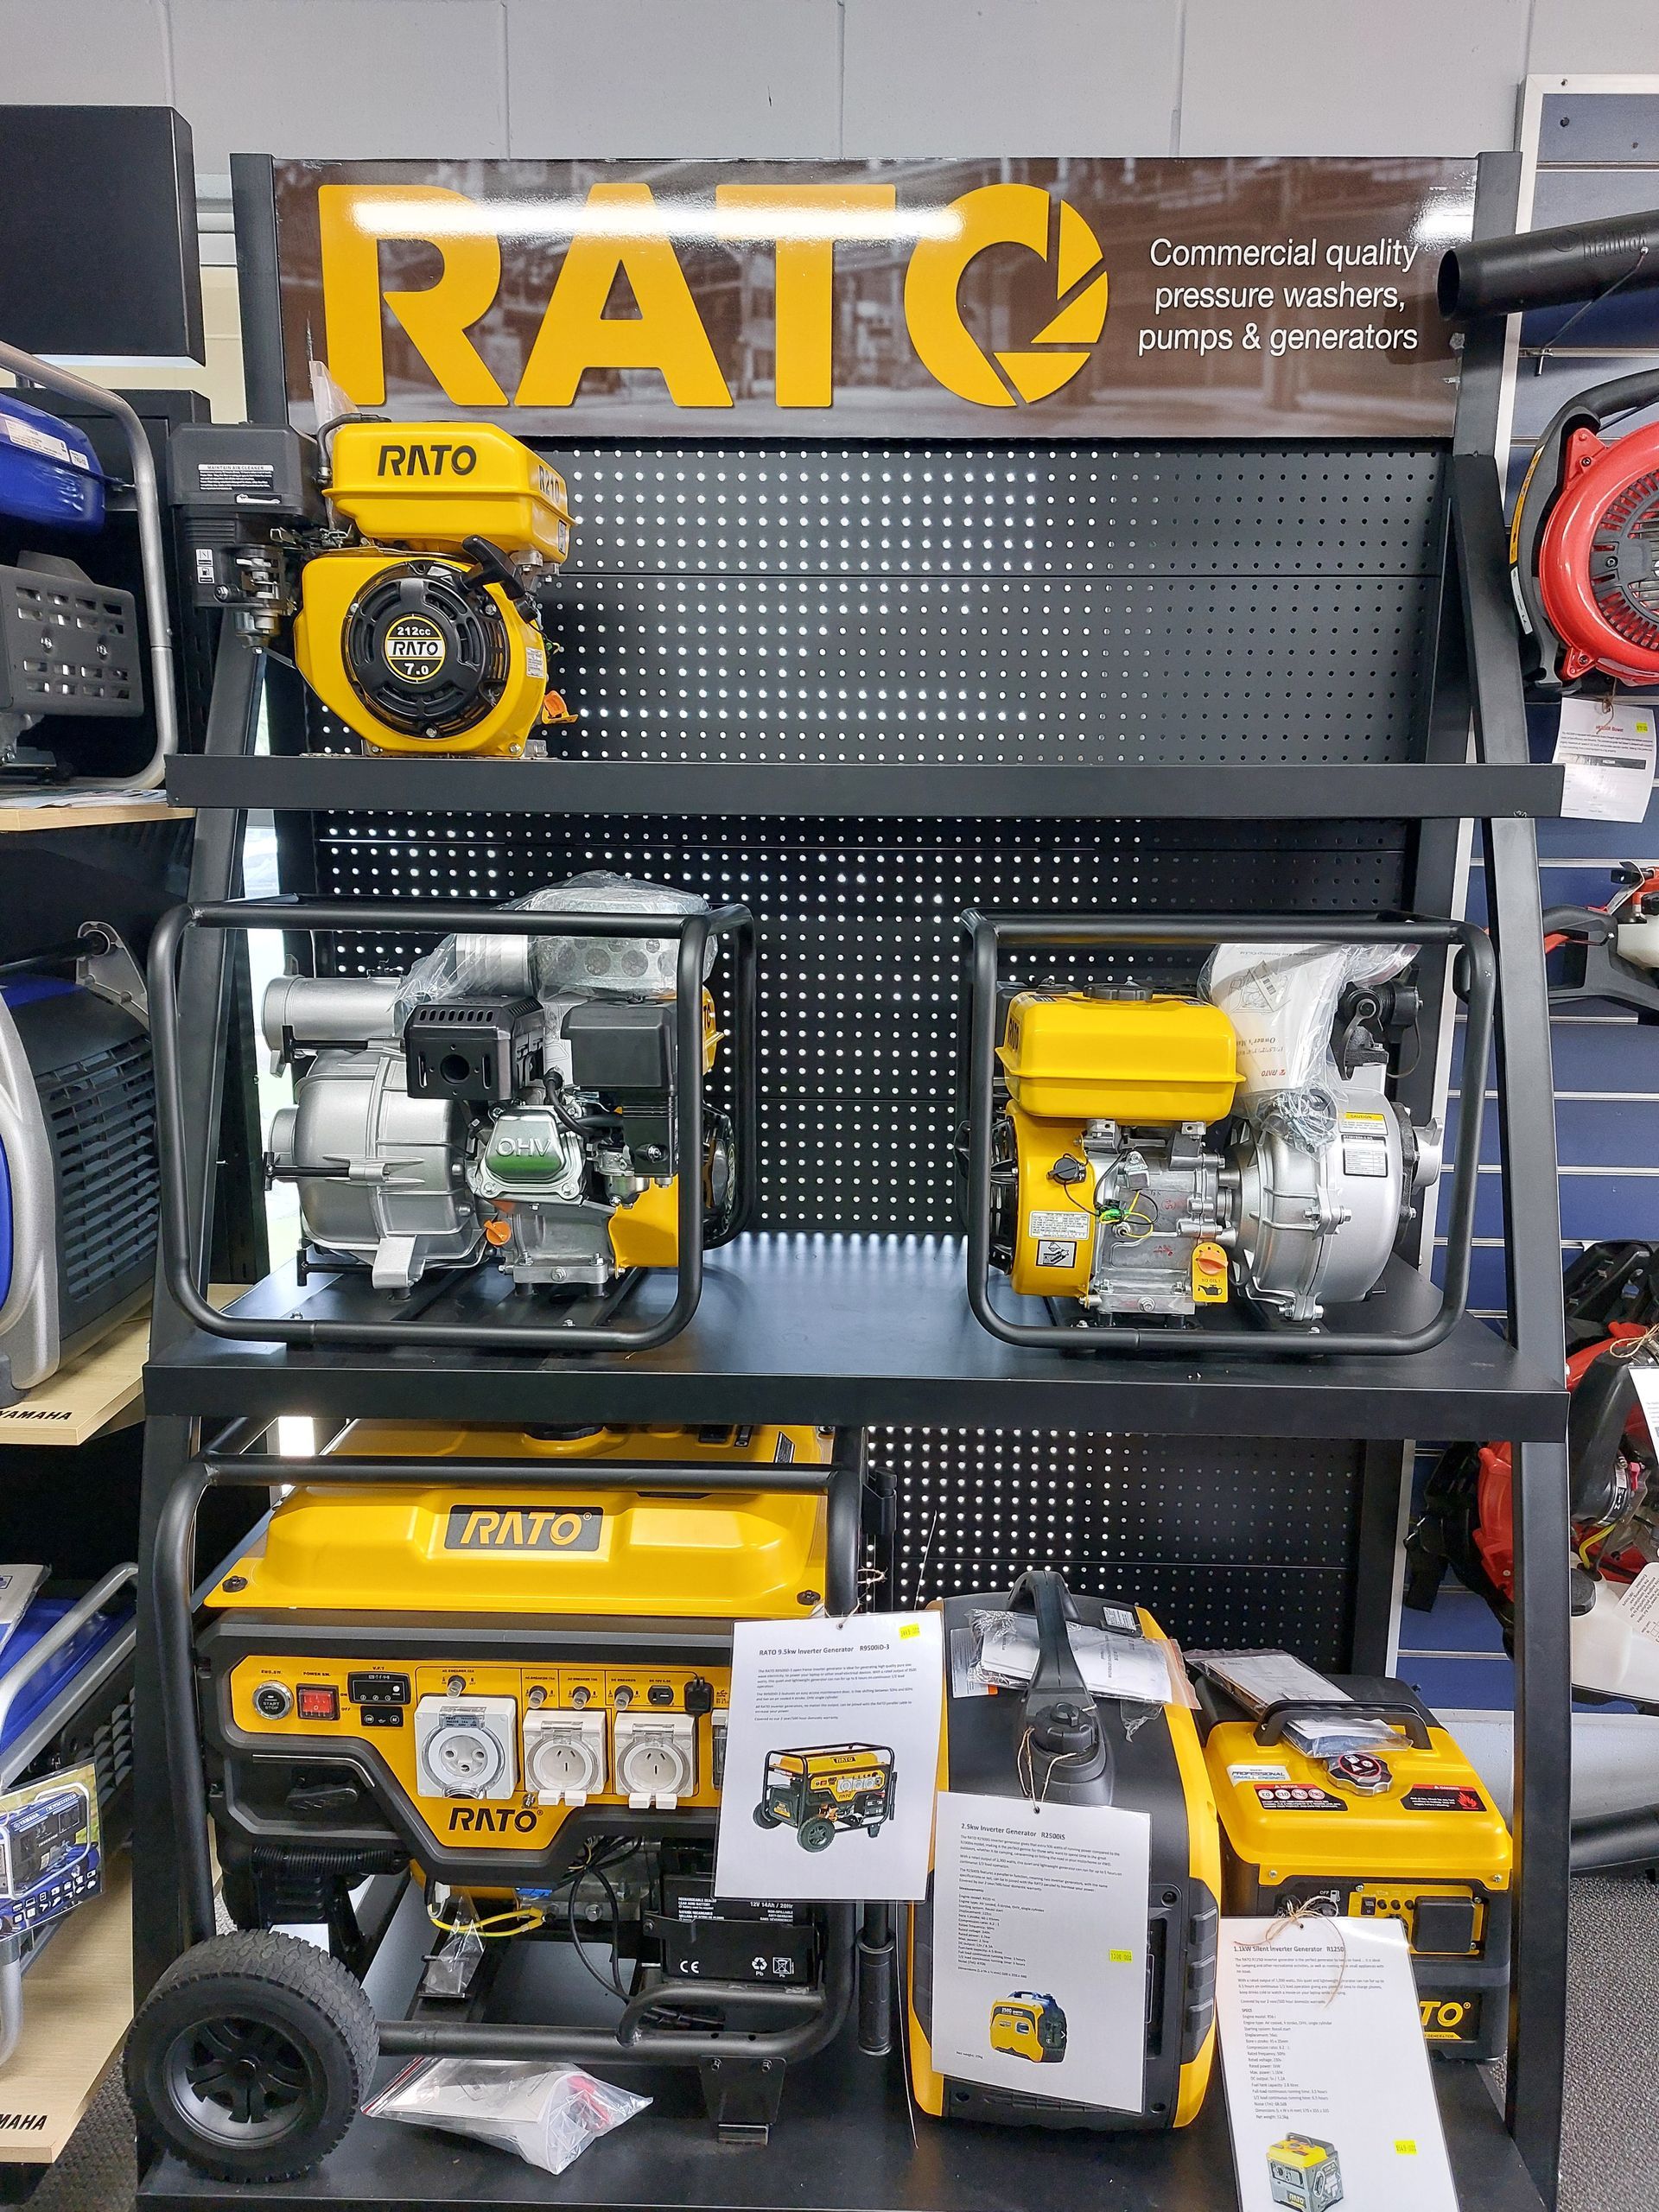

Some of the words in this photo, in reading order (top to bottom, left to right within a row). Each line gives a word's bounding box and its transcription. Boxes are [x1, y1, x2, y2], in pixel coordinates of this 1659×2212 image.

[1150, 238, 1316, 268] Commercial
[1327, 239, 1418, 273] quality
[318, 182, 1108, 407] RATO
[1155, 281, 1275, 313] pressure
[1284, 281, 1405, 311] washers,
[1139, 326, 1233, 355] pumps
[1242, 324, 1260, 349] &
[1270, 323, 1418, 356] generators
[378, 445, 476, 476] RATO
[539, 465, 560, 503] R210
[397, 626, 431, 636] 212cc
[393, 642, 438, 656] RATO
[404, 663, 429, 675] 7.0
[496, 1138, 551, 1157] OHV
[459, 1511, 582, 1547] RATO
[859, 1644, 890, 1652] R9500iD-3
[17, 1813, 40, 1827] YAMAHA
[450, 1808, 537, 1834] RATO
[961, 1823, 979, 1831] 2.5kw
[980, 1826, 1004, 1834] Inverter
[1006, 1828, 1036, 1837] Generator
[1041, 1832, 1065, 1840] R2500iS
[680, 1960, 699, 1974] CE
[1420, 2001, 1463, 2027] TO
